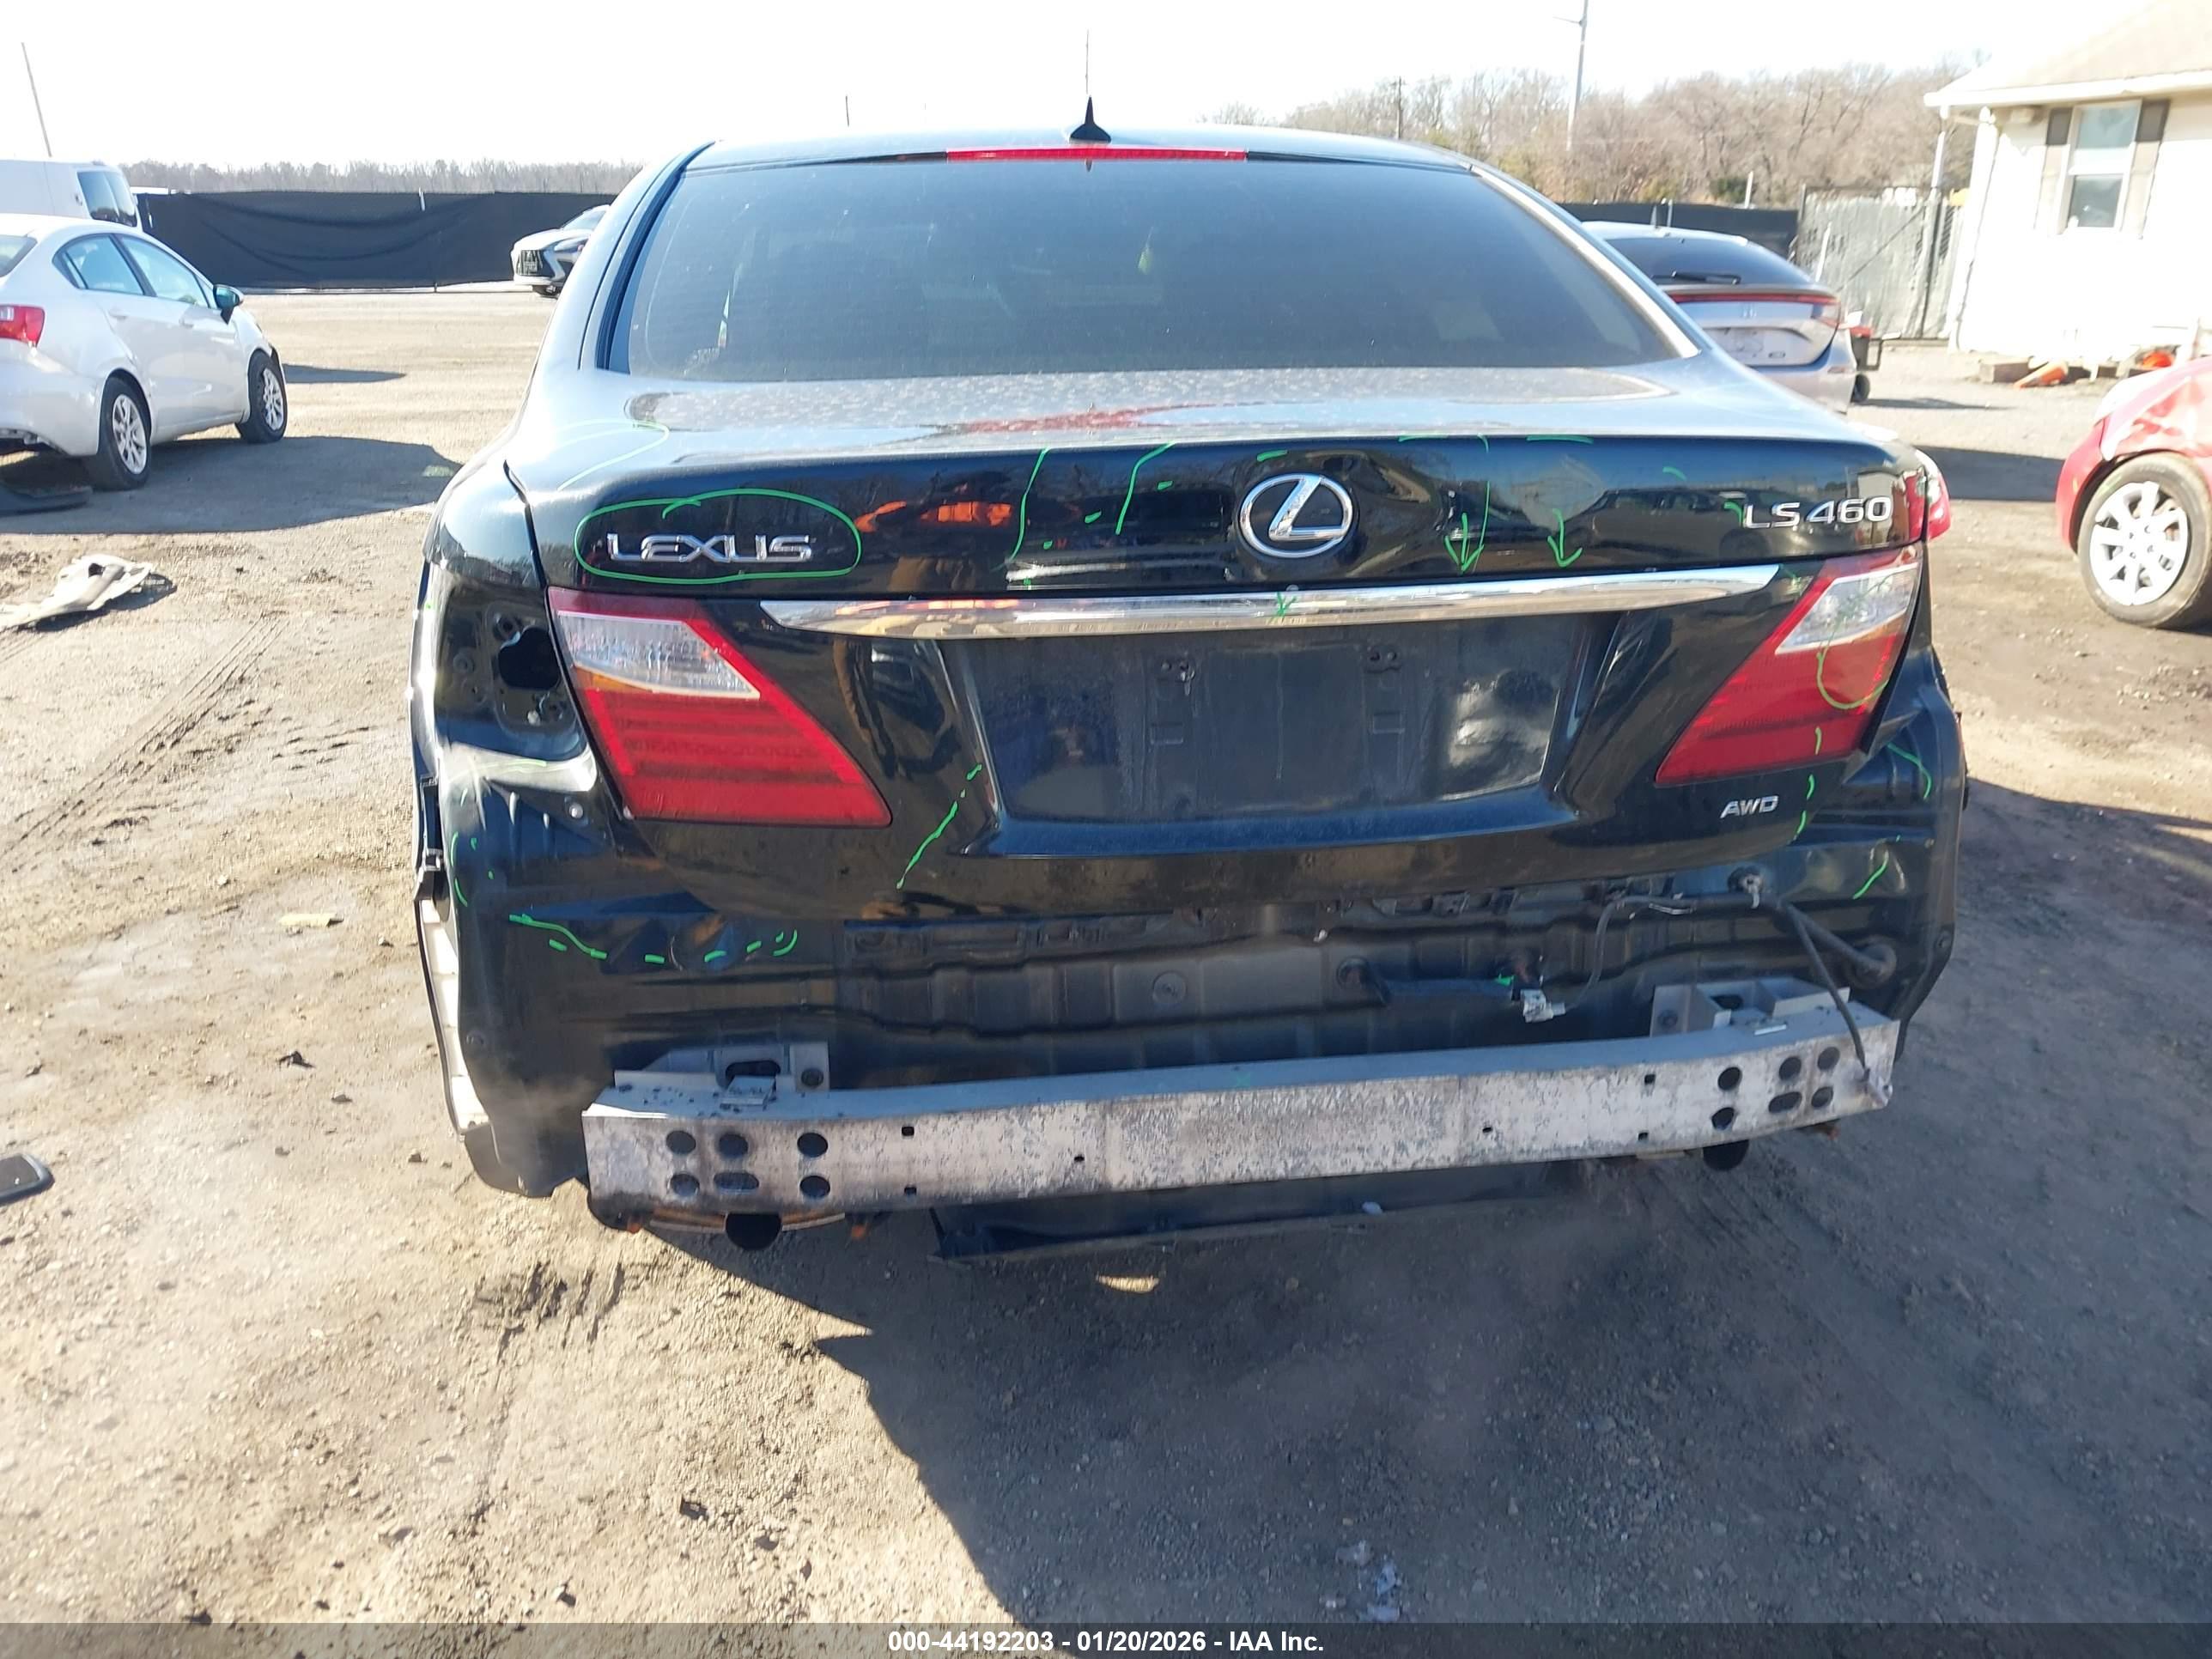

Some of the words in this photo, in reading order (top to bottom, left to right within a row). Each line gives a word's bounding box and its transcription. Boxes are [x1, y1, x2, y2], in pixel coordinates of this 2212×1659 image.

[1743, 501, 1801, 529] LS
[1806, 496, 1893, 525] 460
[606, 532, 812, 563] LEXUS
[1719, 795, 1779, 818] AWD
